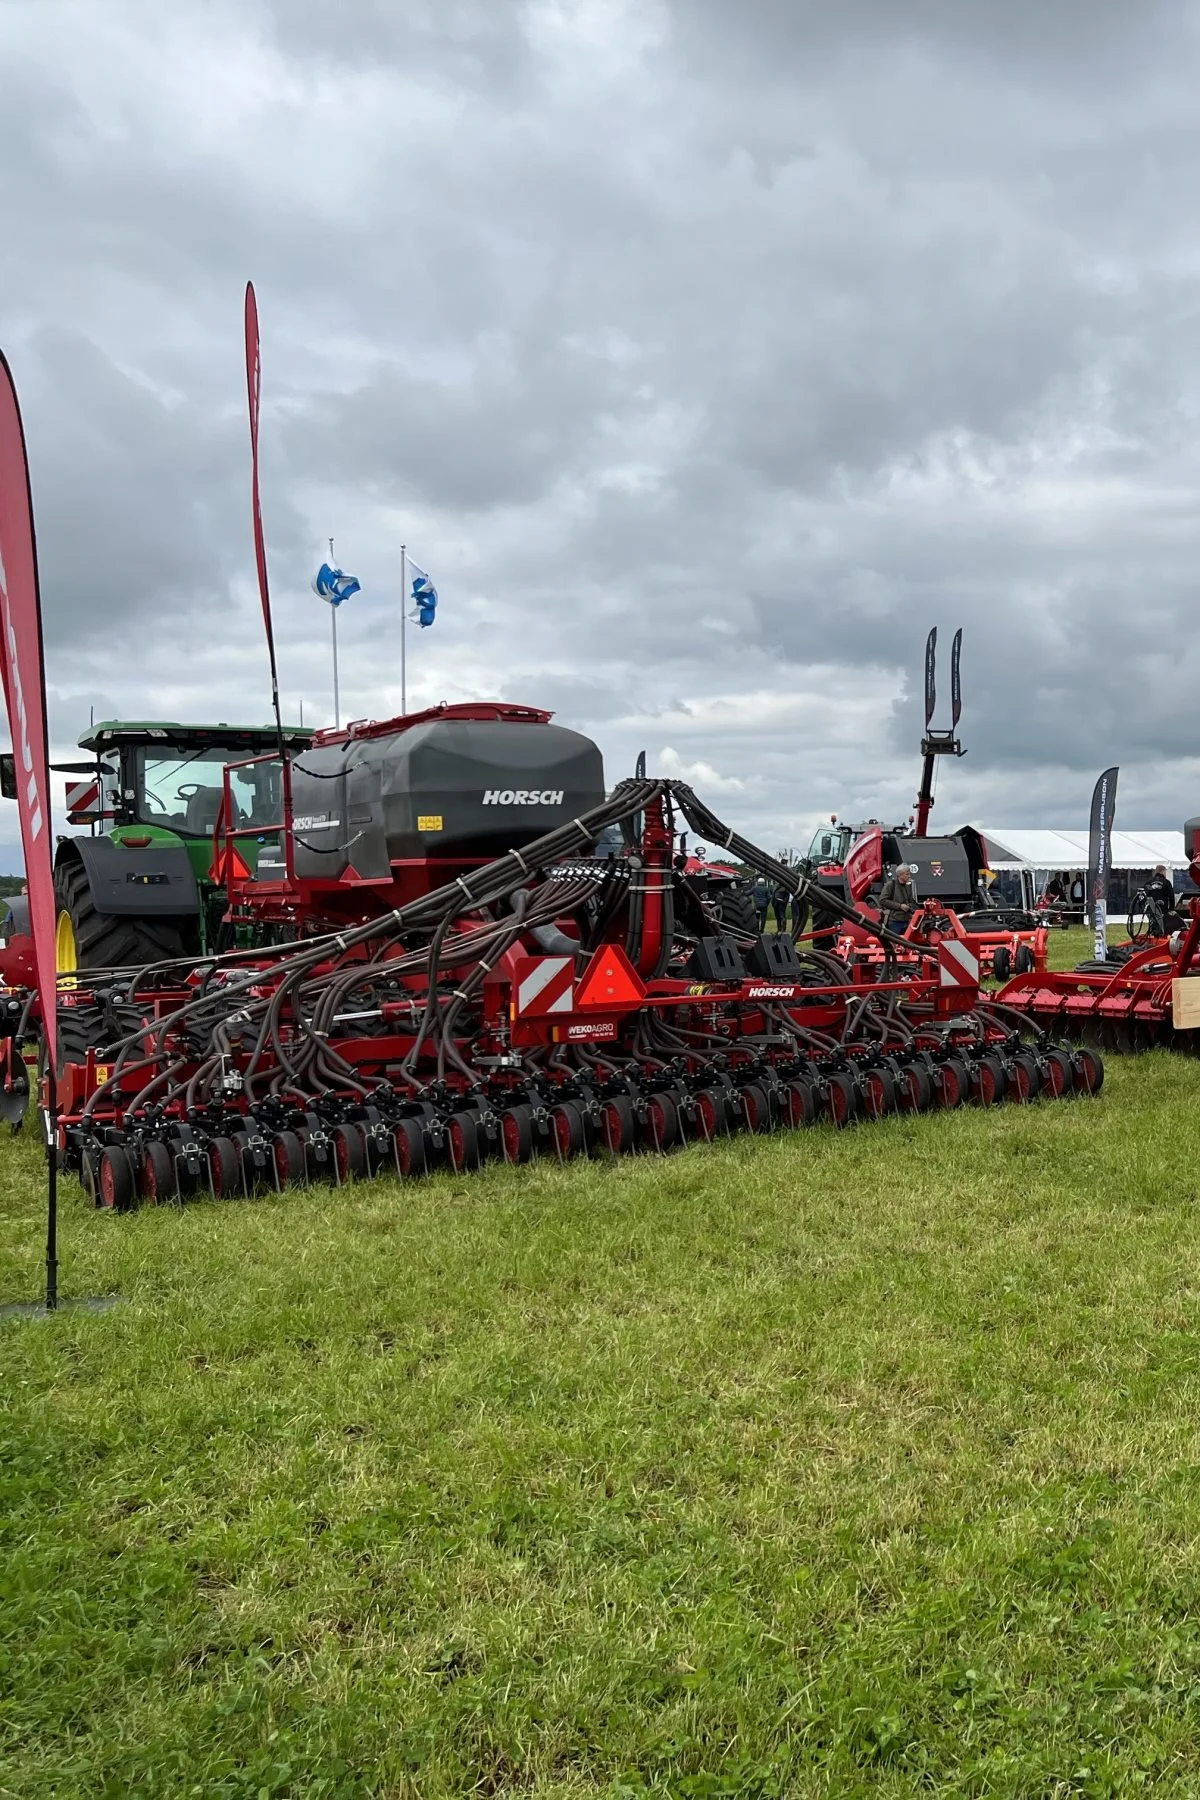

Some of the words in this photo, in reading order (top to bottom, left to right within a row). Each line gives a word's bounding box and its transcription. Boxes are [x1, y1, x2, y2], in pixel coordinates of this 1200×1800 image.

[482, 790, 564, 805] HORSCH
[1100, 778, 1108, 831] FERGUSON
[749, 987, 795, 997] HORSCH
[568, 1023, 614, 1034] WEKOAGRO
